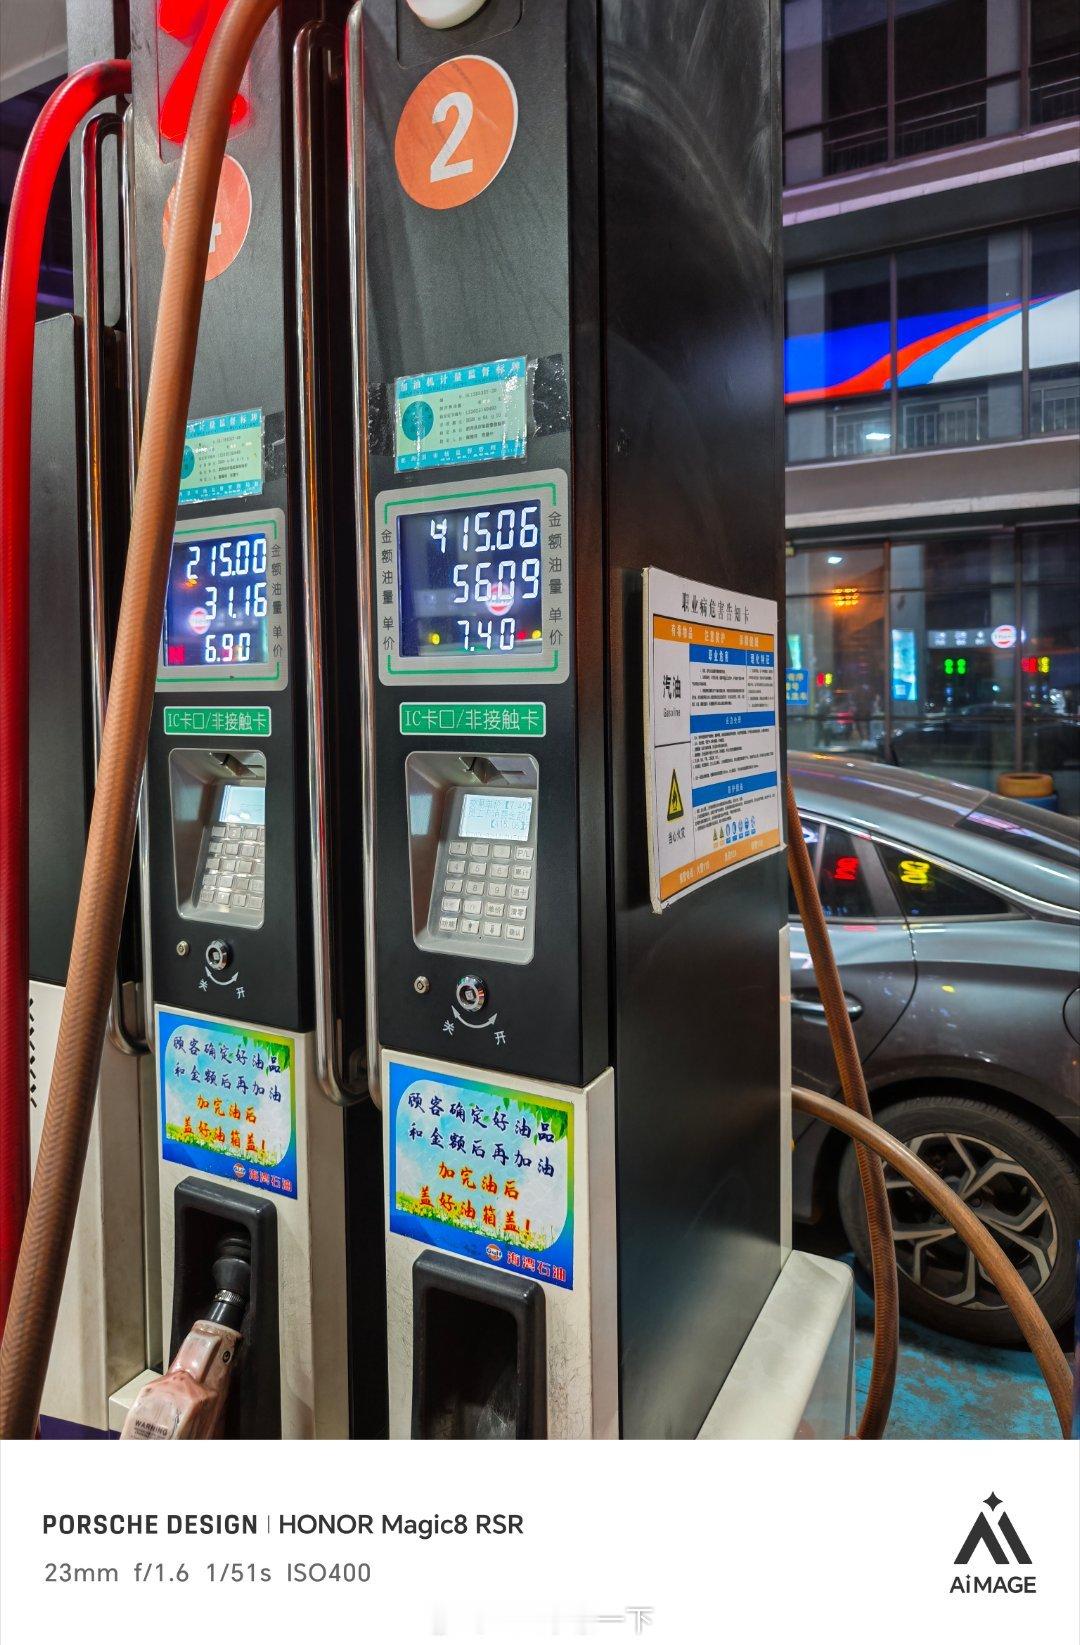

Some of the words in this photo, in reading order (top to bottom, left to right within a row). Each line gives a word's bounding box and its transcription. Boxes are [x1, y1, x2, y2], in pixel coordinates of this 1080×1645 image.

[430, 91, 474, 183] 2
[430, 507, 538, 553] 415.06
[186, 538, 267, 580] 215.00
[453, 558, 540, 603] 56.09
[205, 582, 267, 620] 31.16
[205, 633, 250, 663] 6.90
[458, 618, 516, 652] 7.40
[663, 675, 681, 699] 汽油
[236, 986, 246, 999] 开
[174, 1036, 282, 1074] 顾客确定好油品
[494, 1031, 506, 1045] 开
[174, 1062, 282, 1102] 和金额后再加油
[197, 1095, 257, 1124] 加完油后
[408, 1092, 556, 1144] 顾客确定好油品
[408, 1122, 555, 1177] 和金额后再加油
[438, 1162, 519, 1200] 加完油后
[507, 1250, 566, 1281] 海湾石油
[134, 1420, 168, 1436] WARNING
